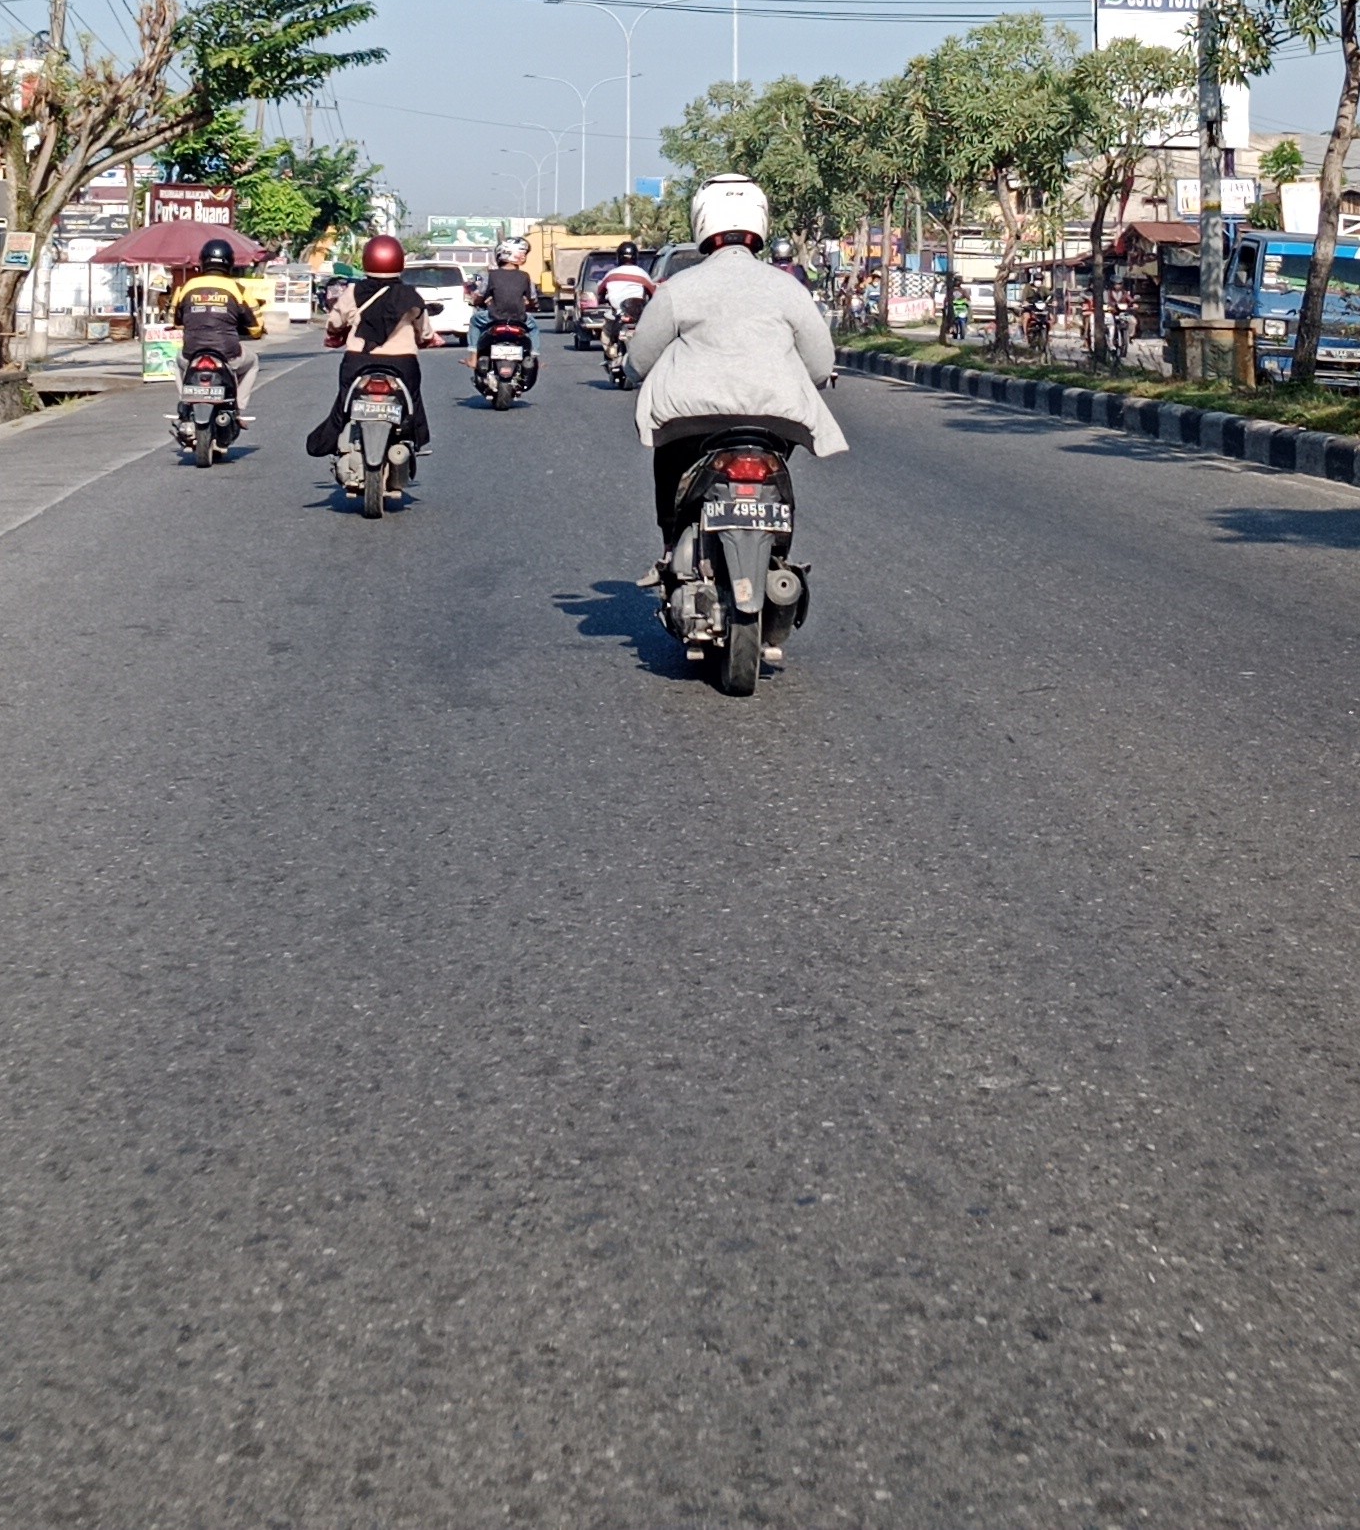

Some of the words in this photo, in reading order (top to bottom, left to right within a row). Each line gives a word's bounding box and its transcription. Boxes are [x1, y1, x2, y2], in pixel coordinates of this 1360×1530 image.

[194, 200, 230, 224] Buana
[191, 292, 228, 303] maxim
[706, 501, 726, 518] BM
[733, 503, 766, 518] 4955
[772, 503, 790, 519] FC
